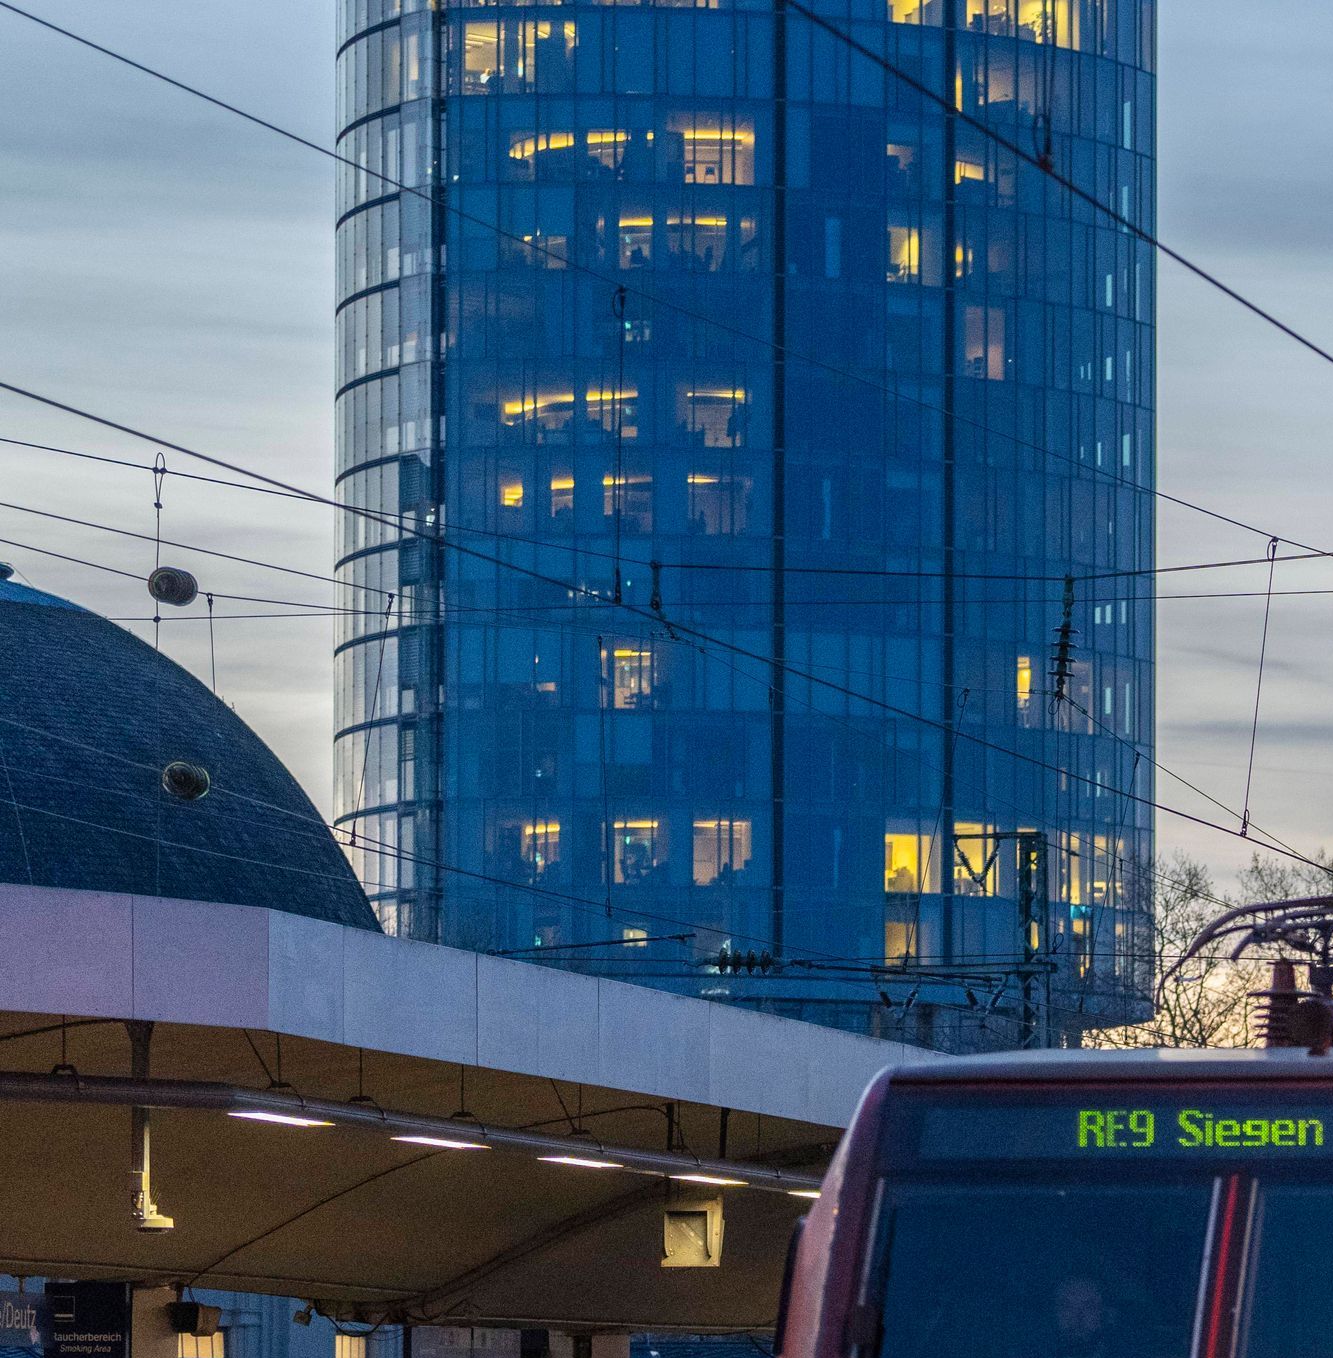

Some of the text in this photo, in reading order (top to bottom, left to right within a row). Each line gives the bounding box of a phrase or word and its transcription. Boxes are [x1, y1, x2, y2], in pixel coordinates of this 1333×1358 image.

[1078, 1109, 1155, 1147] RE9
[1177, 1109, 1325, 1147] Siegen
[0, 1301, 36, 1329] /Deutz
[60, 1344, 111, 1354] Smoking Area
